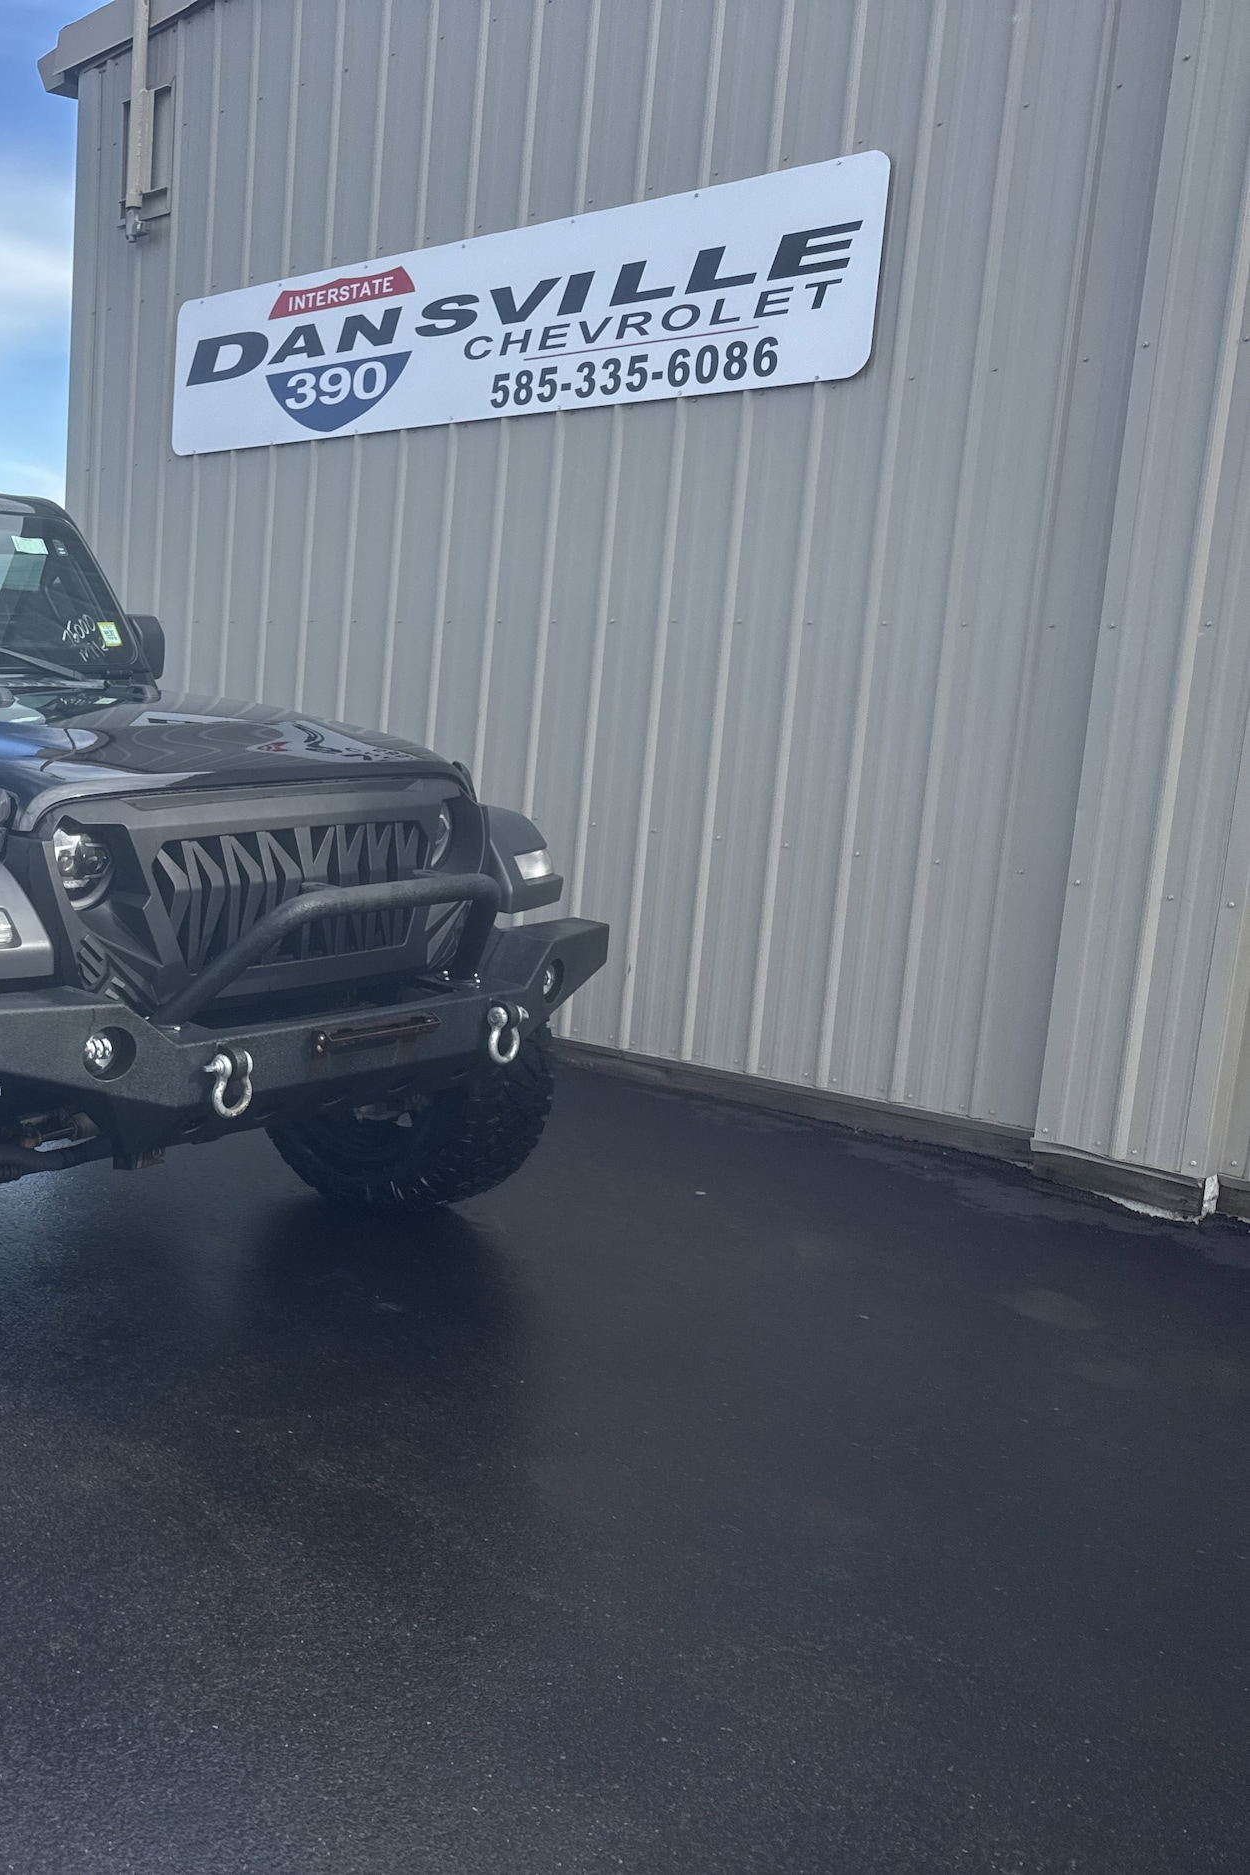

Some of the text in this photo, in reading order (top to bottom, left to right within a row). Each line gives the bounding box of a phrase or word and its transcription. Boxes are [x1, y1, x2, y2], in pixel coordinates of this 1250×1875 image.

[186, 220, 863, 387] DANSVILLE
[288, 276, 393, 312] INTERSTATE
[463, 278, 843, 361] CHEVROLET
[285, 361, 388, 410] 390
[490, 336, 779, 409] 585-335-6086
